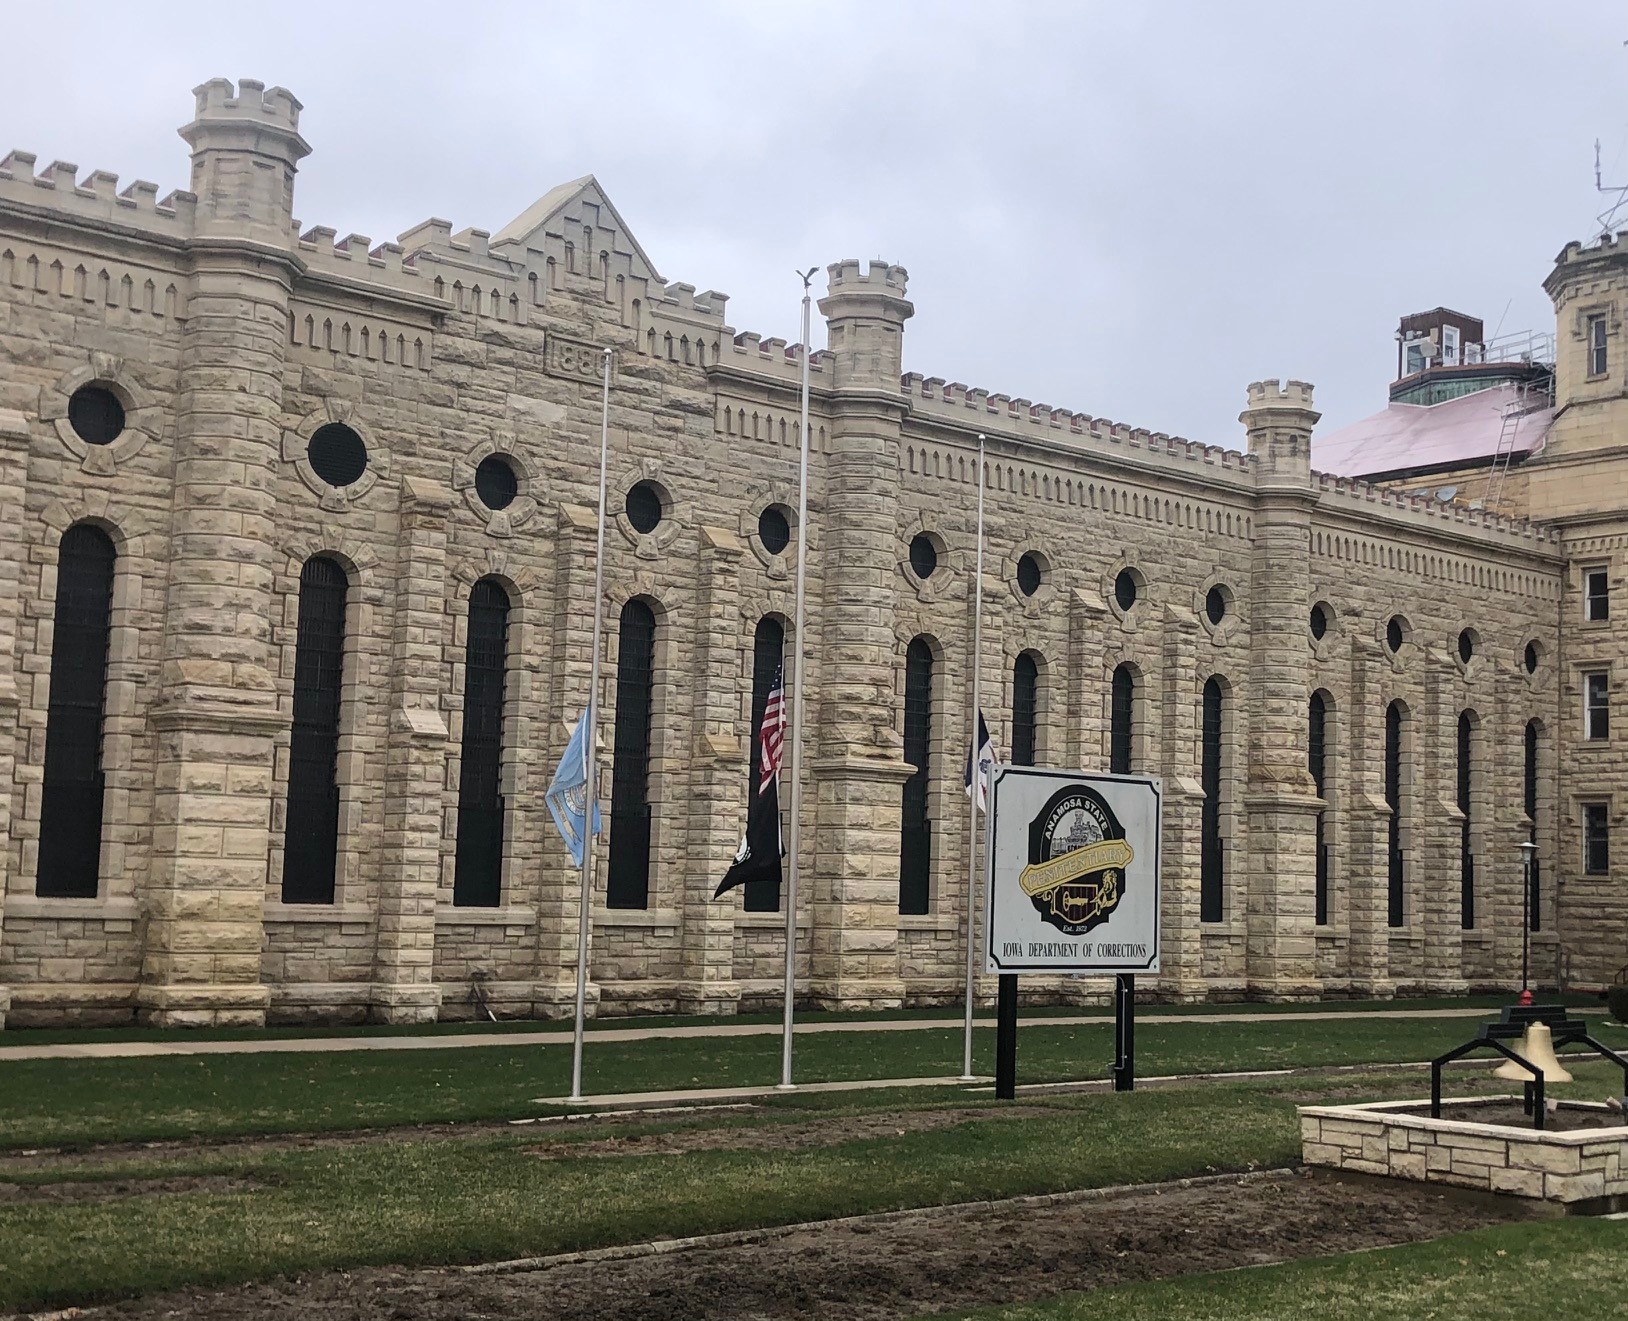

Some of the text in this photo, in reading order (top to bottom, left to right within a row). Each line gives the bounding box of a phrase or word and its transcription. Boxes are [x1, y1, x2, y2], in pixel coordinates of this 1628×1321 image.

[1045, 798, 1108, 840] ANAMOSA STATE
[1027, 849, 1124, 889] PENITENTIARY
[1003, 942, 1146, 958] IOWA DEPARTMENT OF CORRECTIONS
